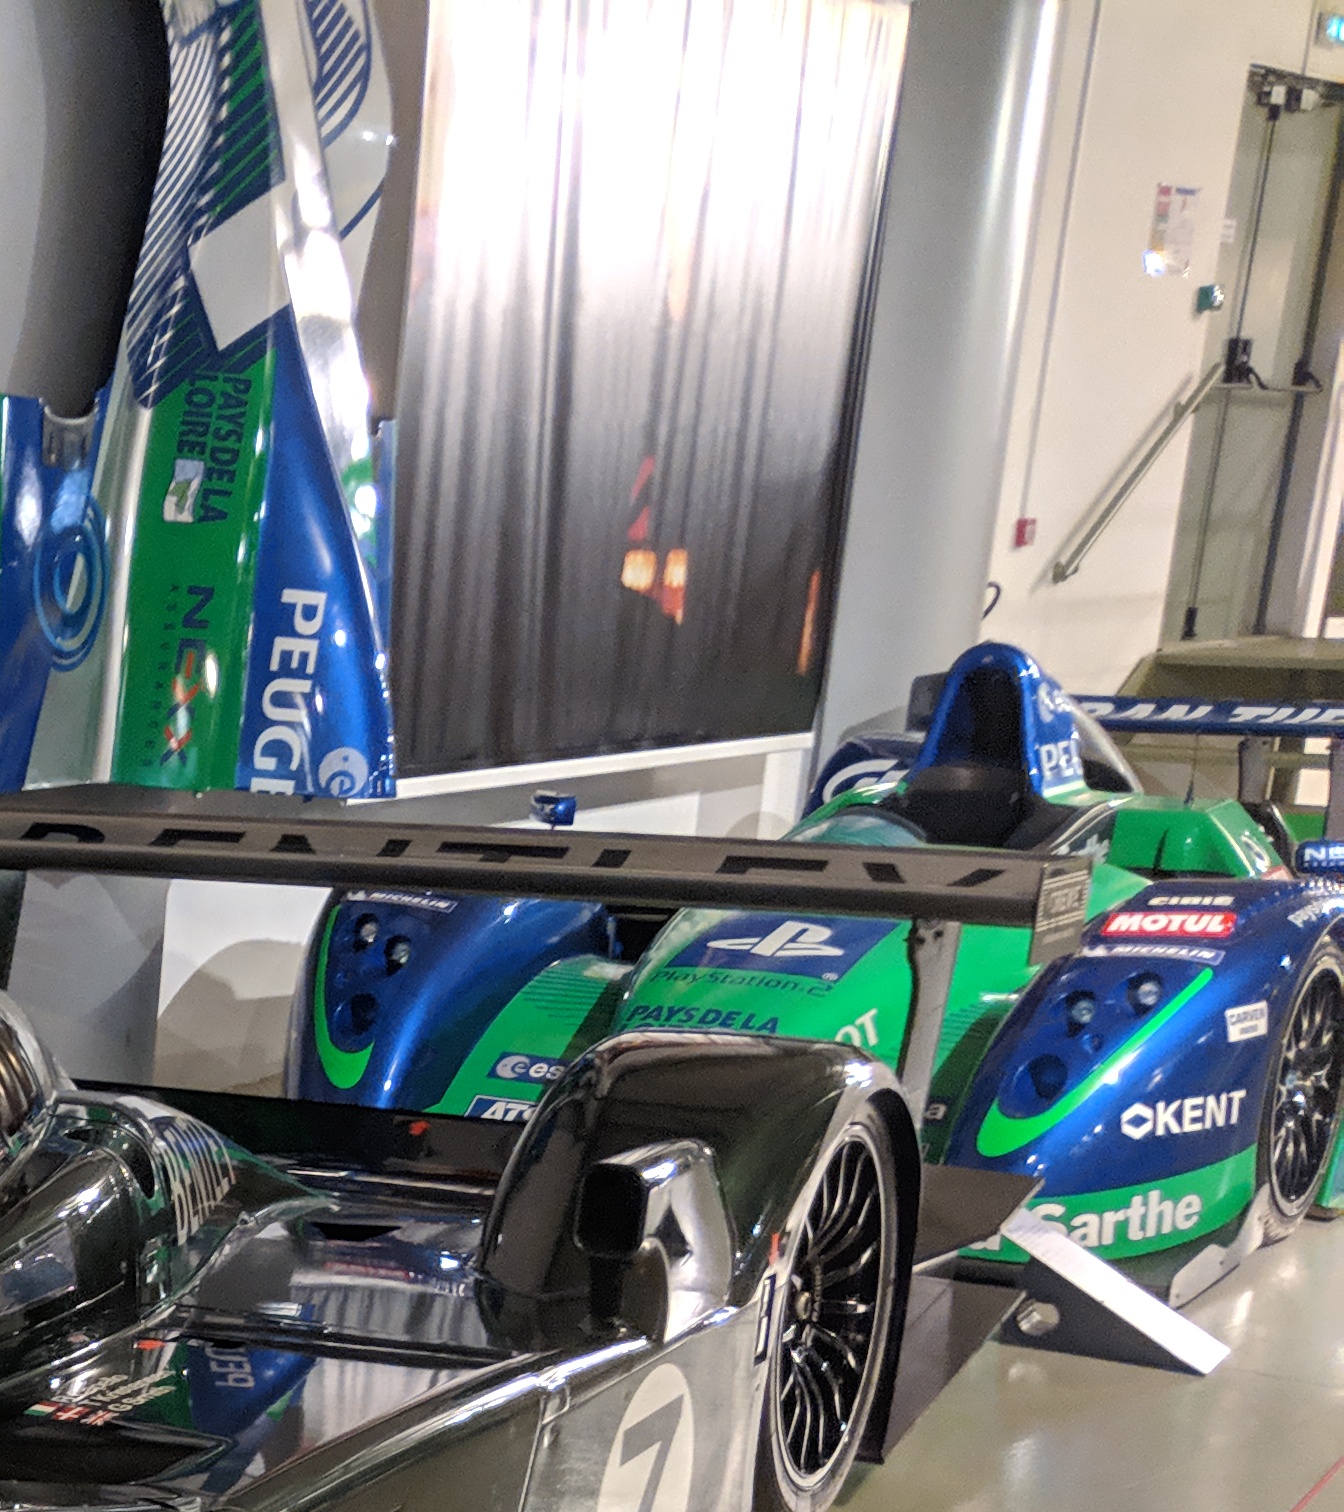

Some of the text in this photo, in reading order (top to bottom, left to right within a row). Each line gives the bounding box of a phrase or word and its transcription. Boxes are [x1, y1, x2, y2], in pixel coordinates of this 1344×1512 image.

[198, 375, 253, 523] PAYS DE LA
[369, 892, 451, 909] MICHELIN
[1106, 914, 1227, 933] MOTUL
[1110, 945, 1216, 960] MICHELIN
[626, 1004, 697, 1024] PAYS
[695, 1008, 738, 1028] DE
[740, 1014, 779, 1034] LA
[1156, 1089, 1247, 1137] KENT
[1036, 1190, 1202, 1250] Sarthe
